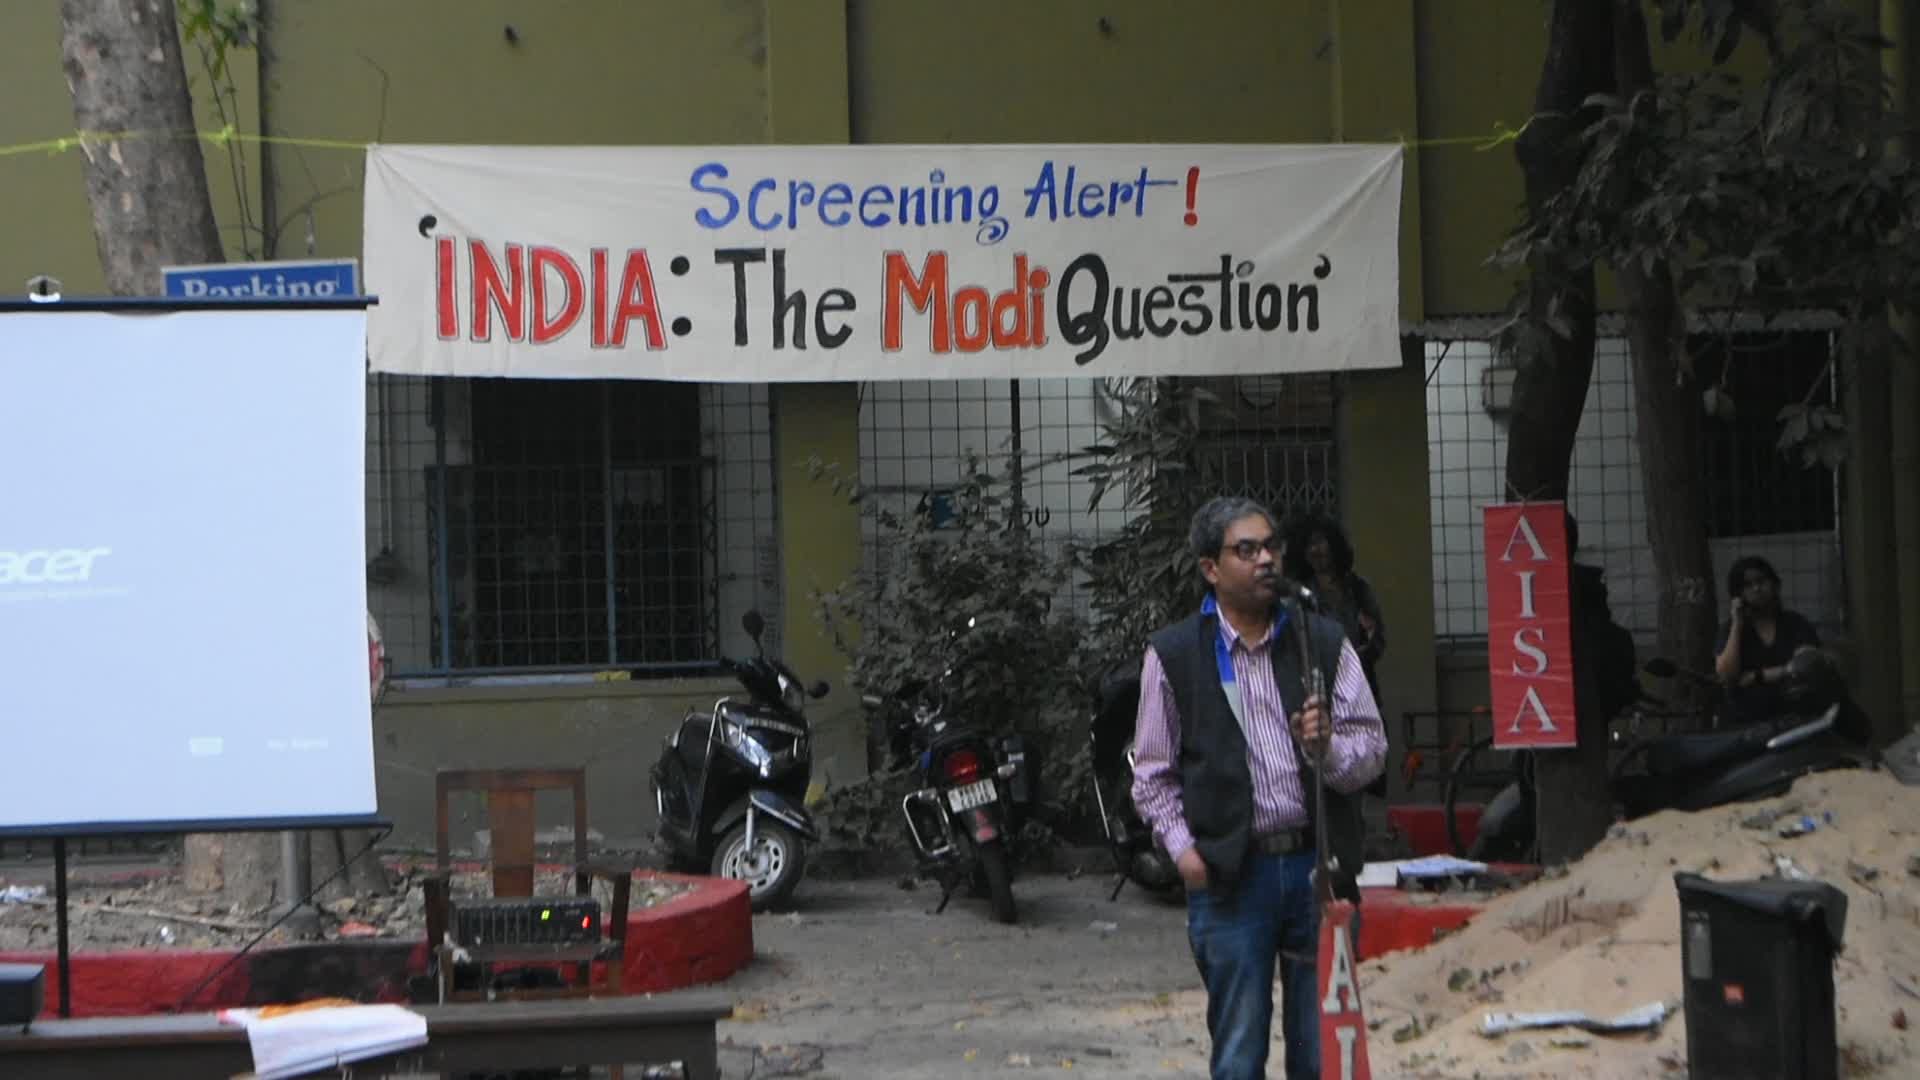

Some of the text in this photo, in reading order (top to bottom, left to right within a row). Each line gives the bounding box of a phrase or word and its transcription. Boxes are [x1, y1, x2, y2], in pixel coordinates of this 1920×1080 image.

[690, 163, 1009, 246] Screening
[714, 247, 857, 351] The
[880, 249, 1051, 354] Modi
[0, 547, 112, 584] acer
[1500, 514, 1557, 734] AISA
